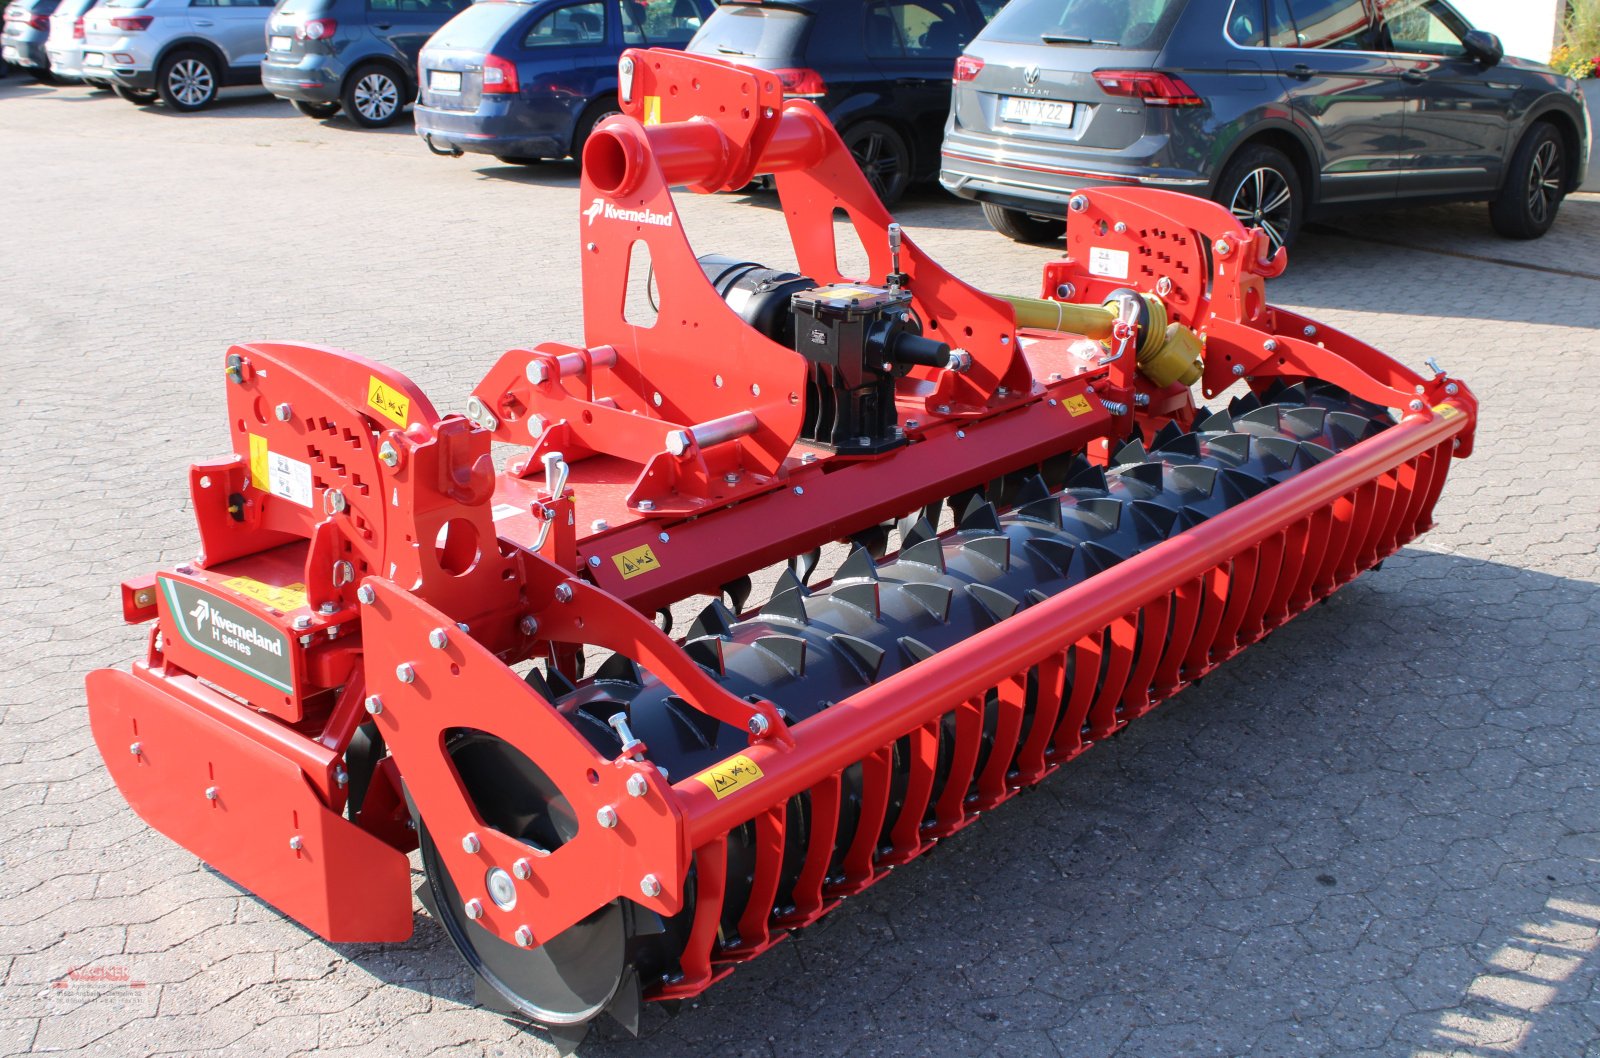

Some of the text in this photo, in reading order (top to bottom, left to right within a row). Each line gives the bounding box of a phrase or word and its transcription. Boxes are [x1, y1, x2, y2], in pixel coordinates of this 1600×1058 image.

[604, 203, 673, 227] Kverneland
[210, 607, 282, 657] Kverneland
[212, 626, 252, 656] H series
